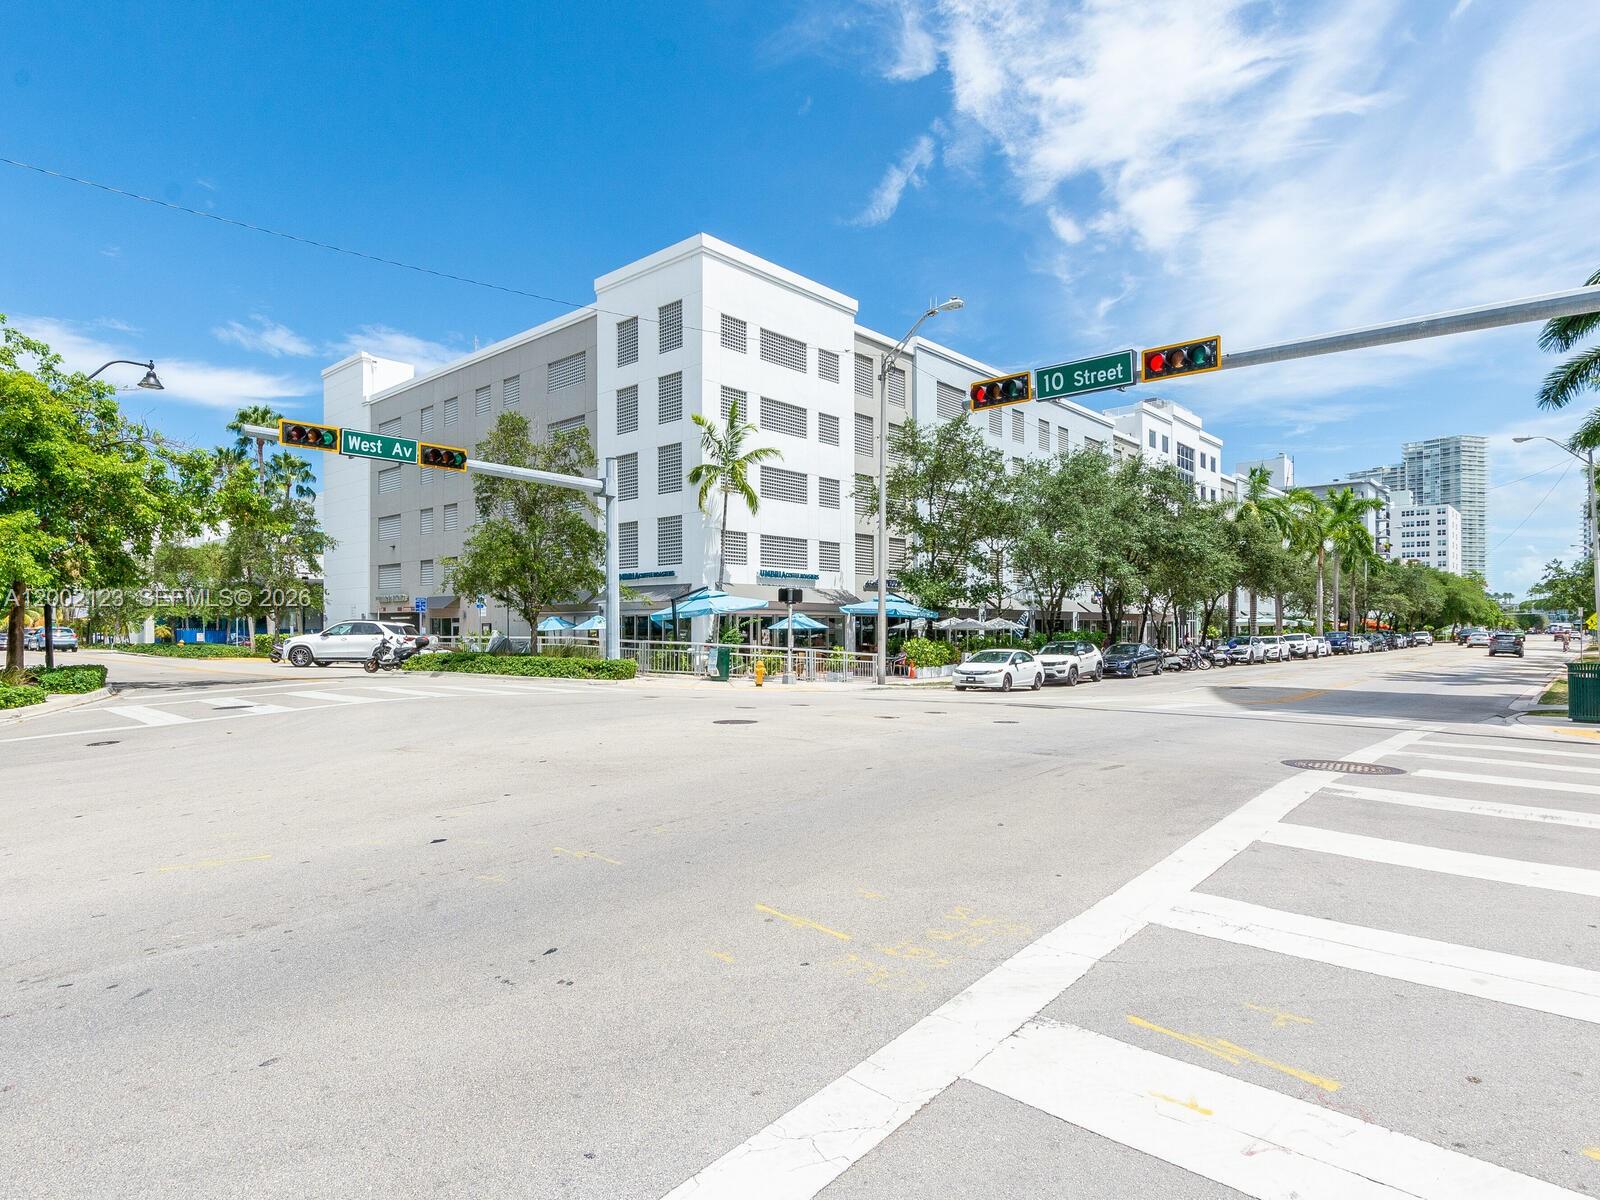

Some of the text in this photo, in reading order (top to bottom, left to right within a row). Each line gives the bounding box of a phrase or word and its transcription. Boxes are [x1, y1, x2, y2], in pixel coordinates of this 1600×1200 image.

[1044, 363, 1123, 392] 10 Street
[348, 435, 412, 458] West Av
[760, 569, 786, 579] UMBRIA
